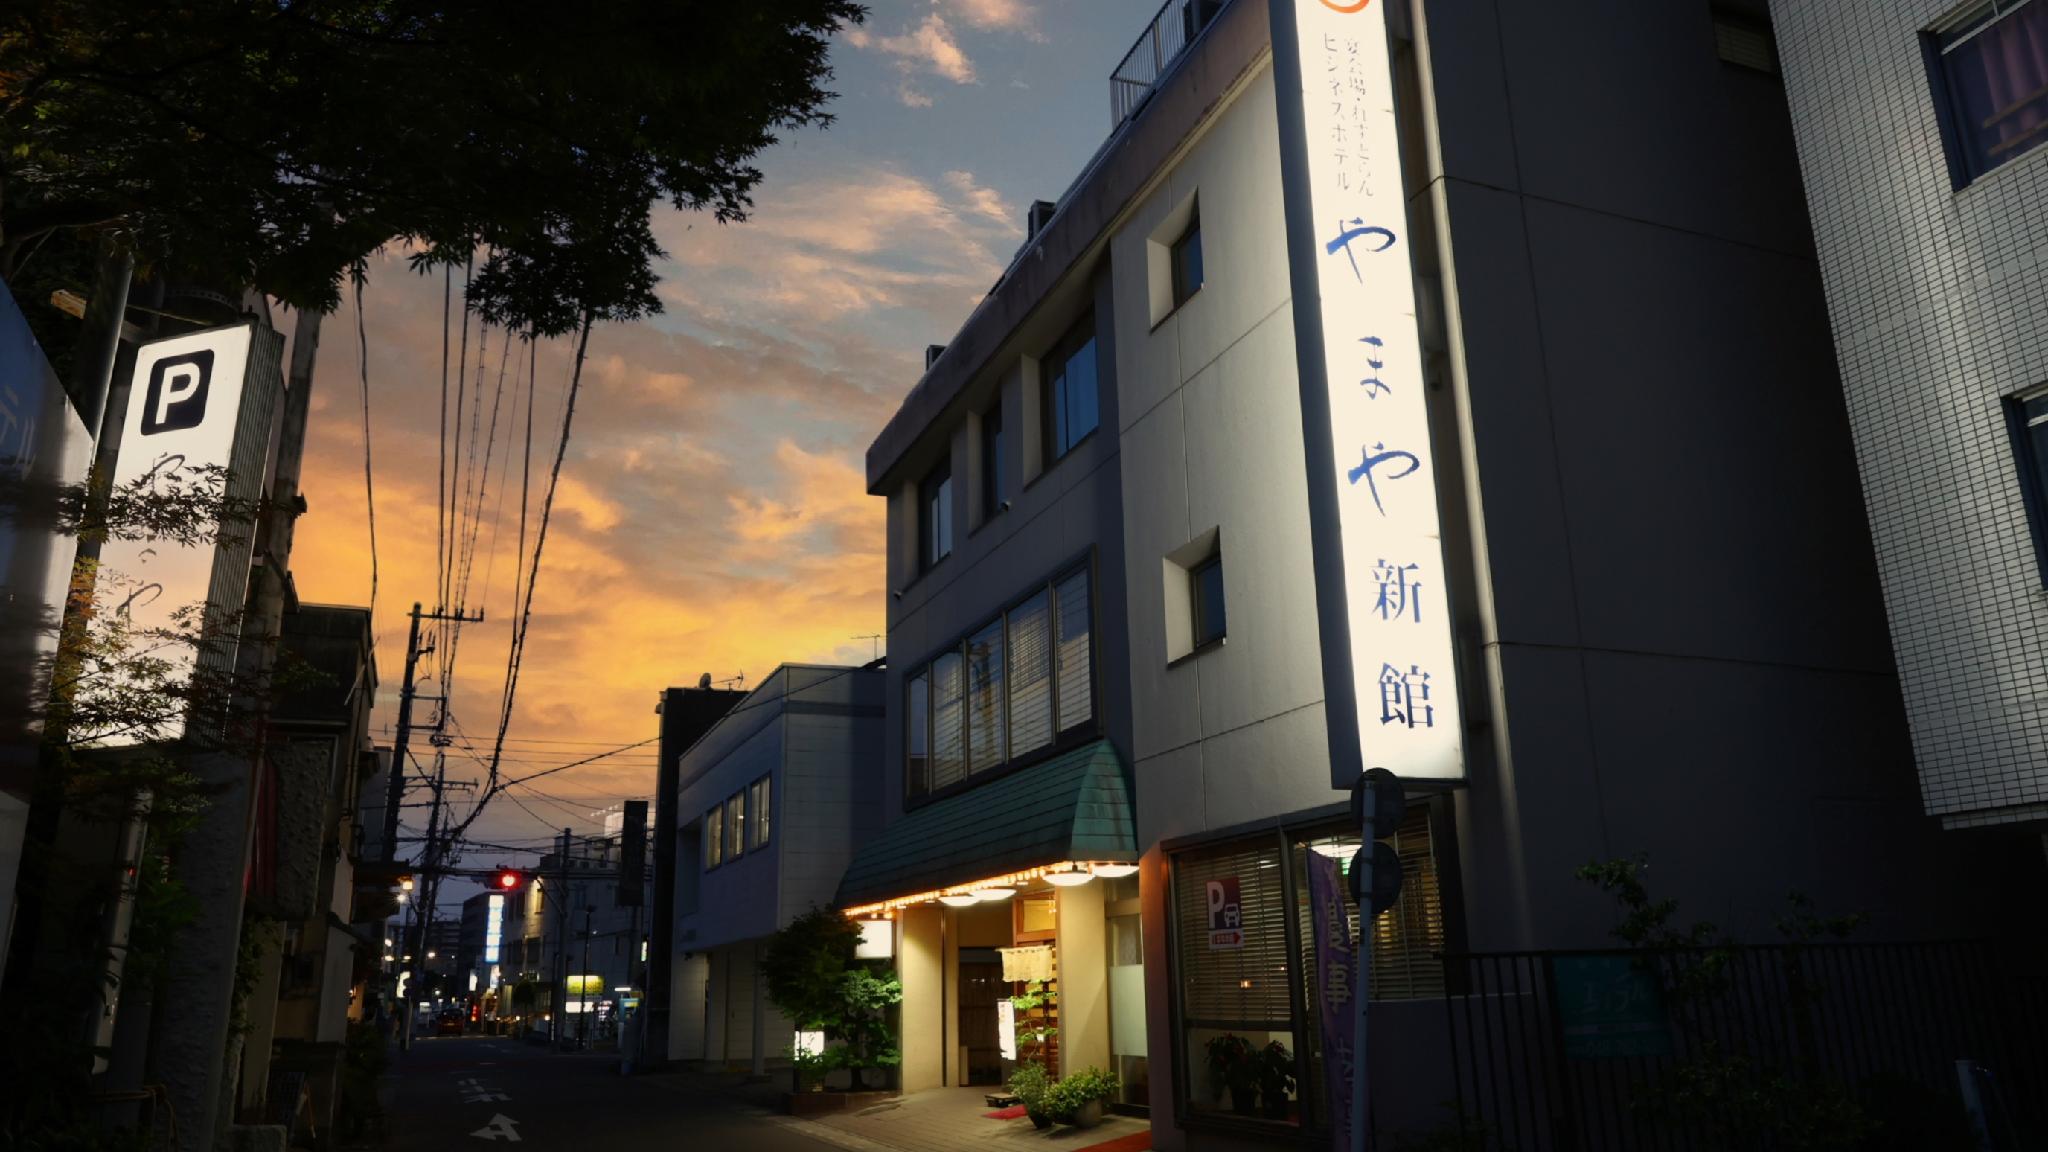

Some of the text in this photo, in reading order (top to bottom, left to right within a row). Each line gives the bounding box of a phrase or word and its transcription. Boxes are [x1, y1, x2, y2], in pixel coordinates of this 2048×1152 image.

[155, 362, 201, 425] P
[1326, 216, 1434, 730] やまや新館
[1207, 880, 1225, 929] P
